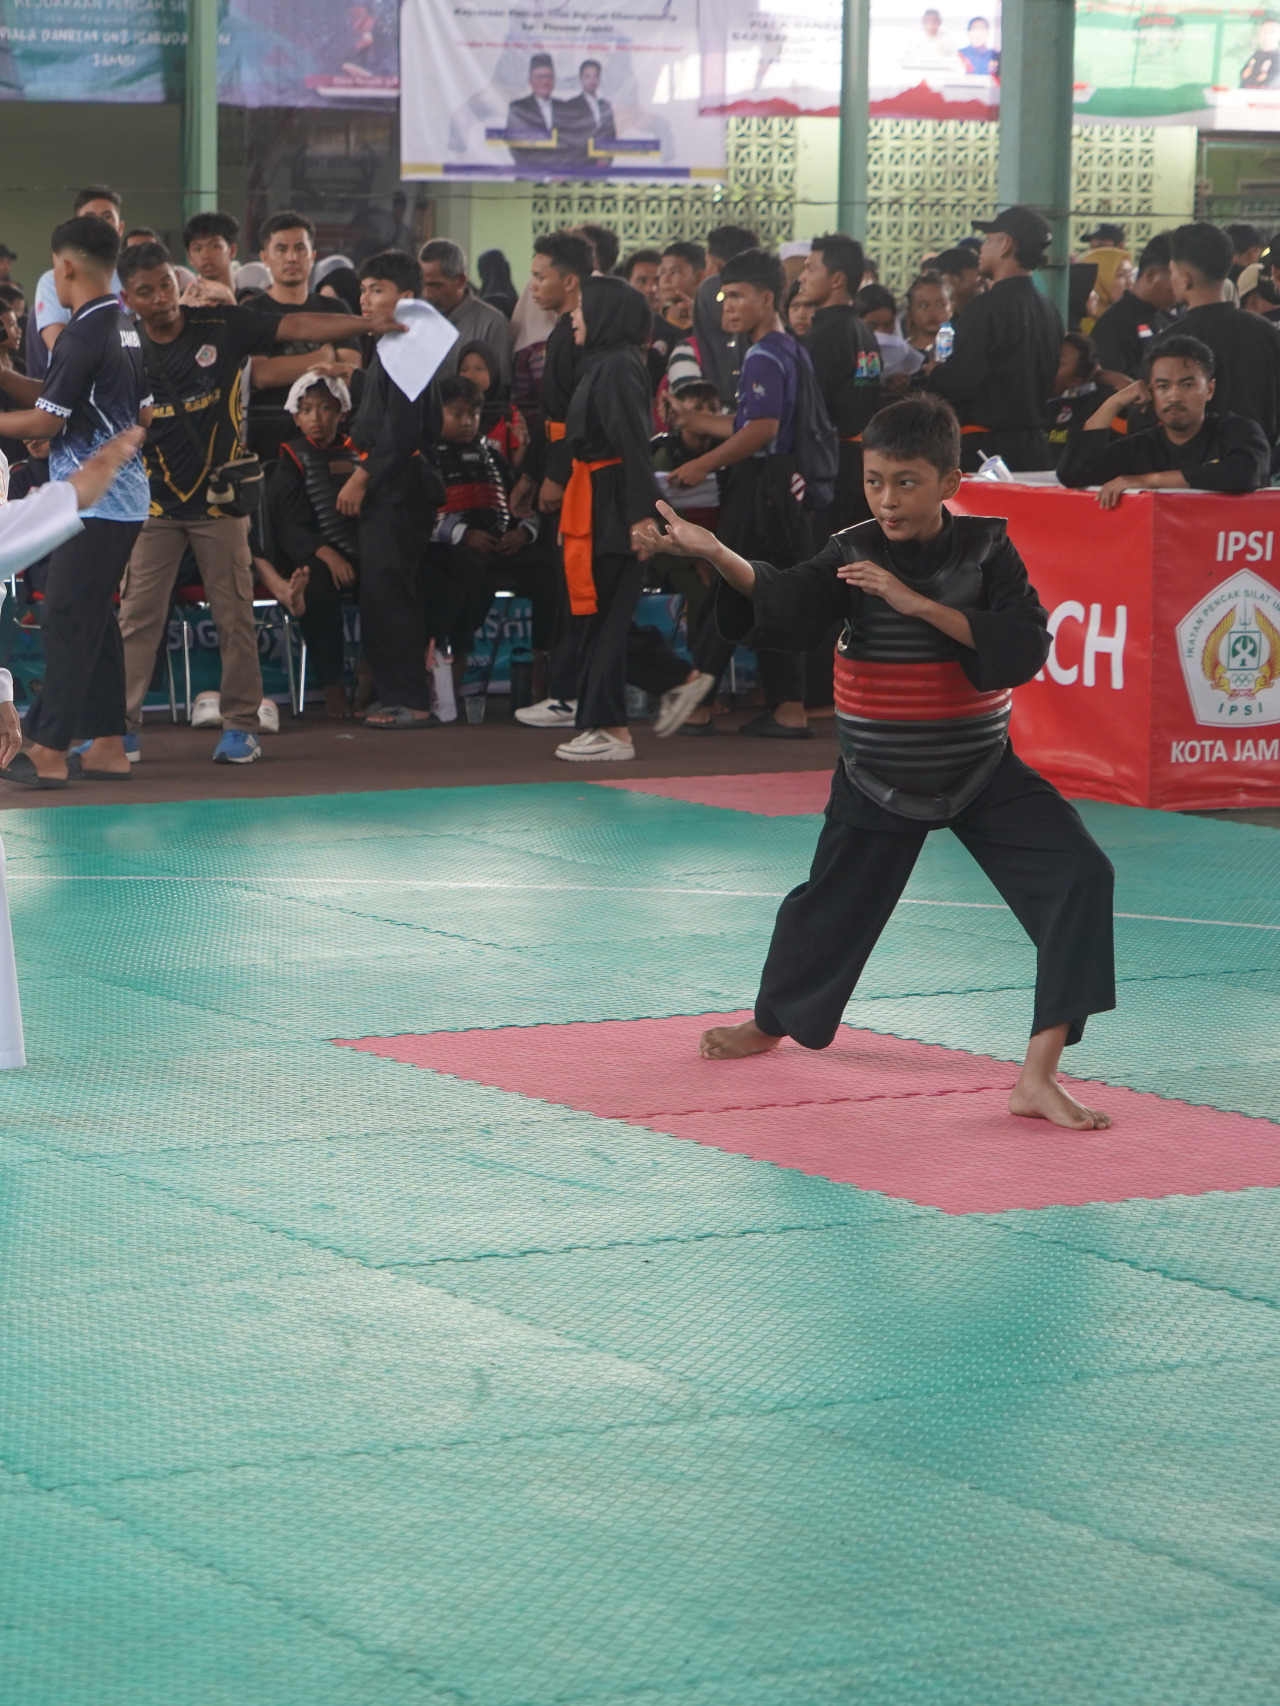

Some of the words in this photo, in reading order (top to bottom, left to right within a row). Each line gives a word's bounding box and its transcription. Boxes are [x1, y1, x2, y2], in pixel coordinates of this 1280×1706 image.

[1216, 531, 1274, 562] IPSI
[1203, 589, 1240, 617] PENCAK
[1244, 589, 1272, 603] SILAT
[1186, 617, 1205, 658] IKATAN
[1217, 702, 1263, 716] IPSI
[1171, 740, 1228, 763] KOTA
